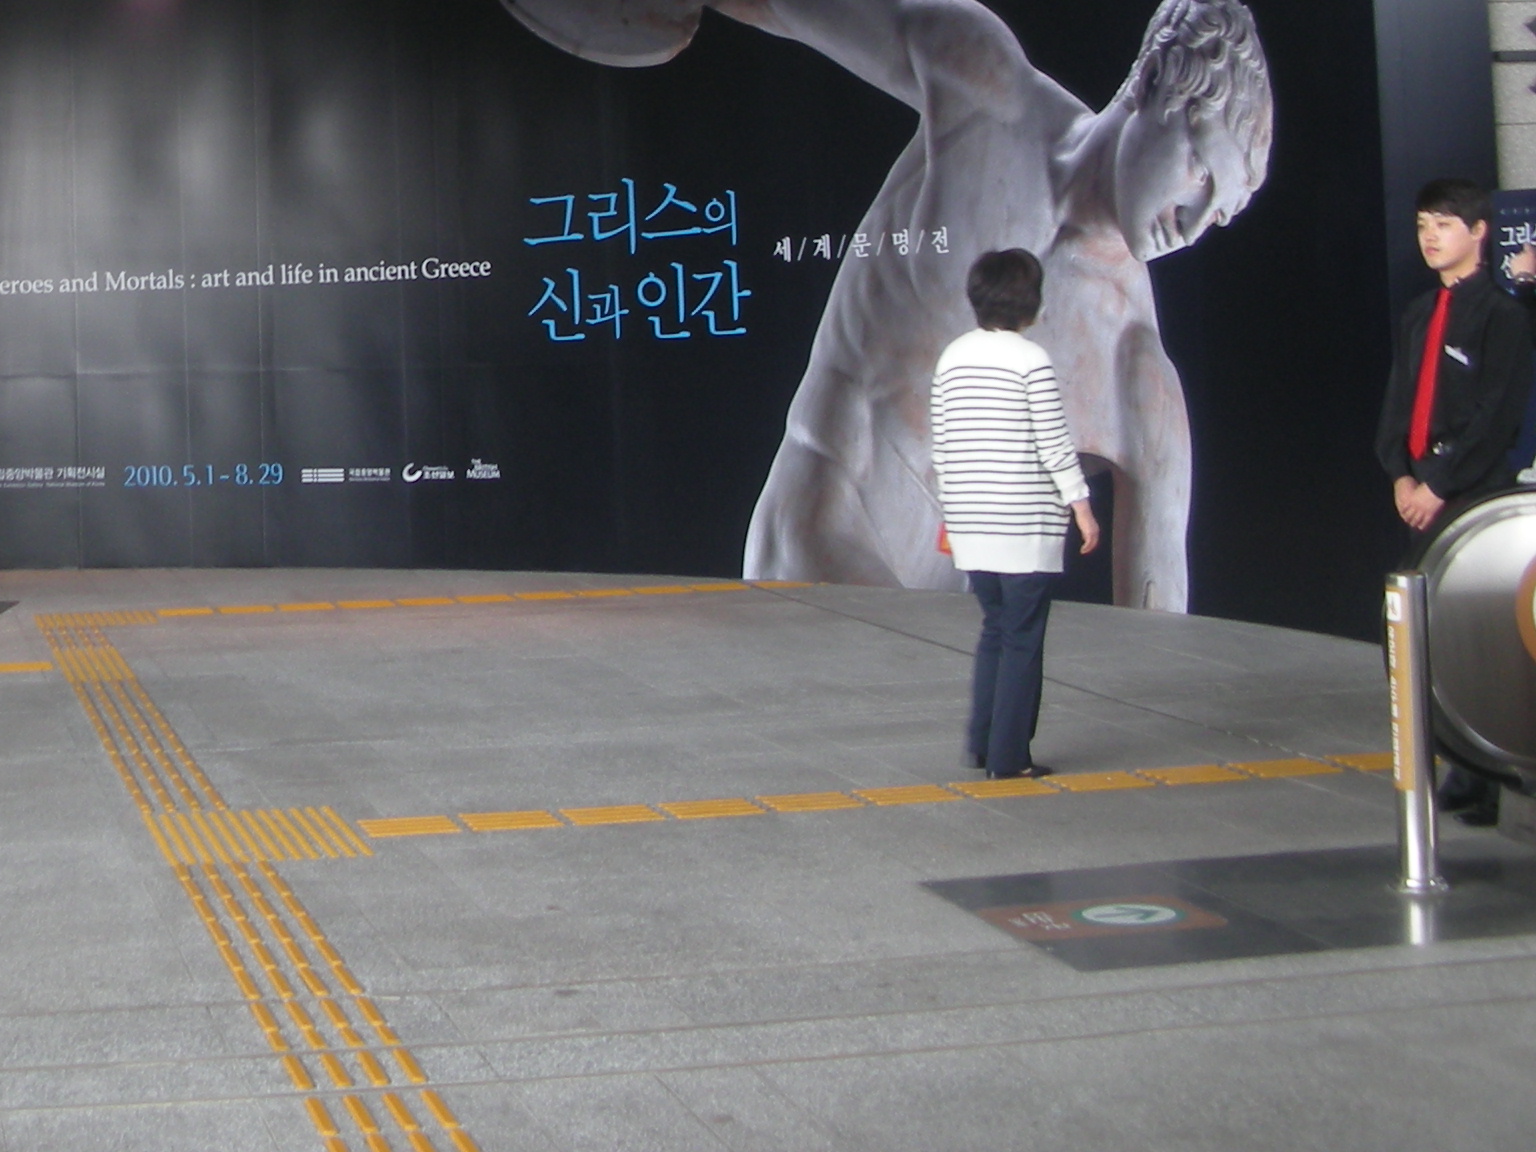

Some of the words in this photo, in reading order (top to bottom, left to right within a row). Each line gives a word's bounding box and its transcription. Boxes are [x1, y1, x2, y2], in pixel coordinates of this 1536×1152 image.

[523, 177, 738, 255] 그리스의
[59, 271, 98, 293] and
[104, 268, 185, 292] Mortals
[201, 269, 230, 288] art
[235, 264, 274, 287] and
[280, 262, 314, 285] life
[318, 262, 339, 284] in
[344, 260, 418, 283] ancient
[421, 256, 492, 280] Greece
